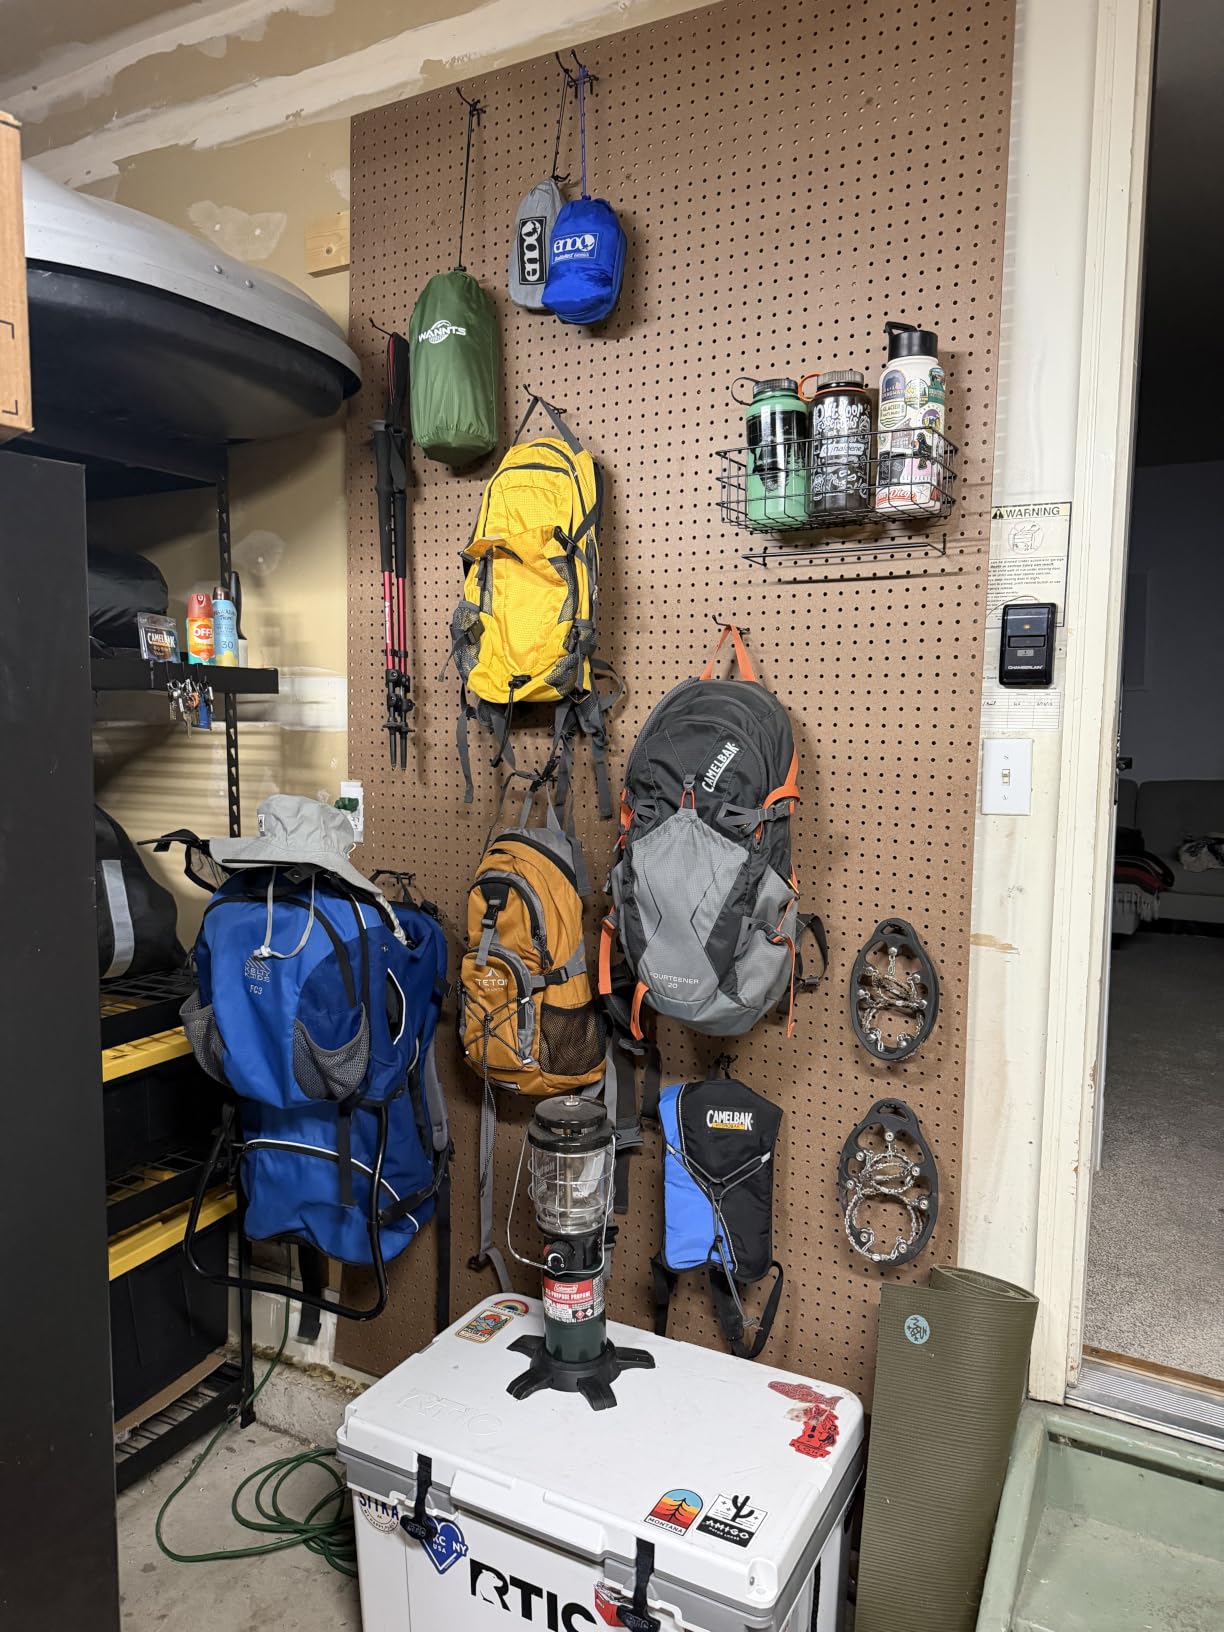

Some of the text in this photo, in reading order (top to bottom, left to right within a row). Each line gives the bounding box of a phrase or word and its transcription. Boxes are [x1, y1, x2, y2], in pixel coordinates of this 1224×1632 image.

[418, 326, 467, 342] WANNTS
[1005, 506, 1060, 518] WARNING
[193, 628, 213, 638] OFF!
[221, 641, 234, 649] 30
[702, 742, 740, 792] CAMELBAK
[250, 984, 262, 995] FC3
[706, 1110, 753, 1131] CAMELBAK
[360, 1493, 400, 1521] SITKA
[648, 1516, 684, 1534] MONTANA
[432, 1544, 447, 1554] USA
[452, 1541, 467, 1555] NY
[469, 1557, 598, 1632] RTIC
